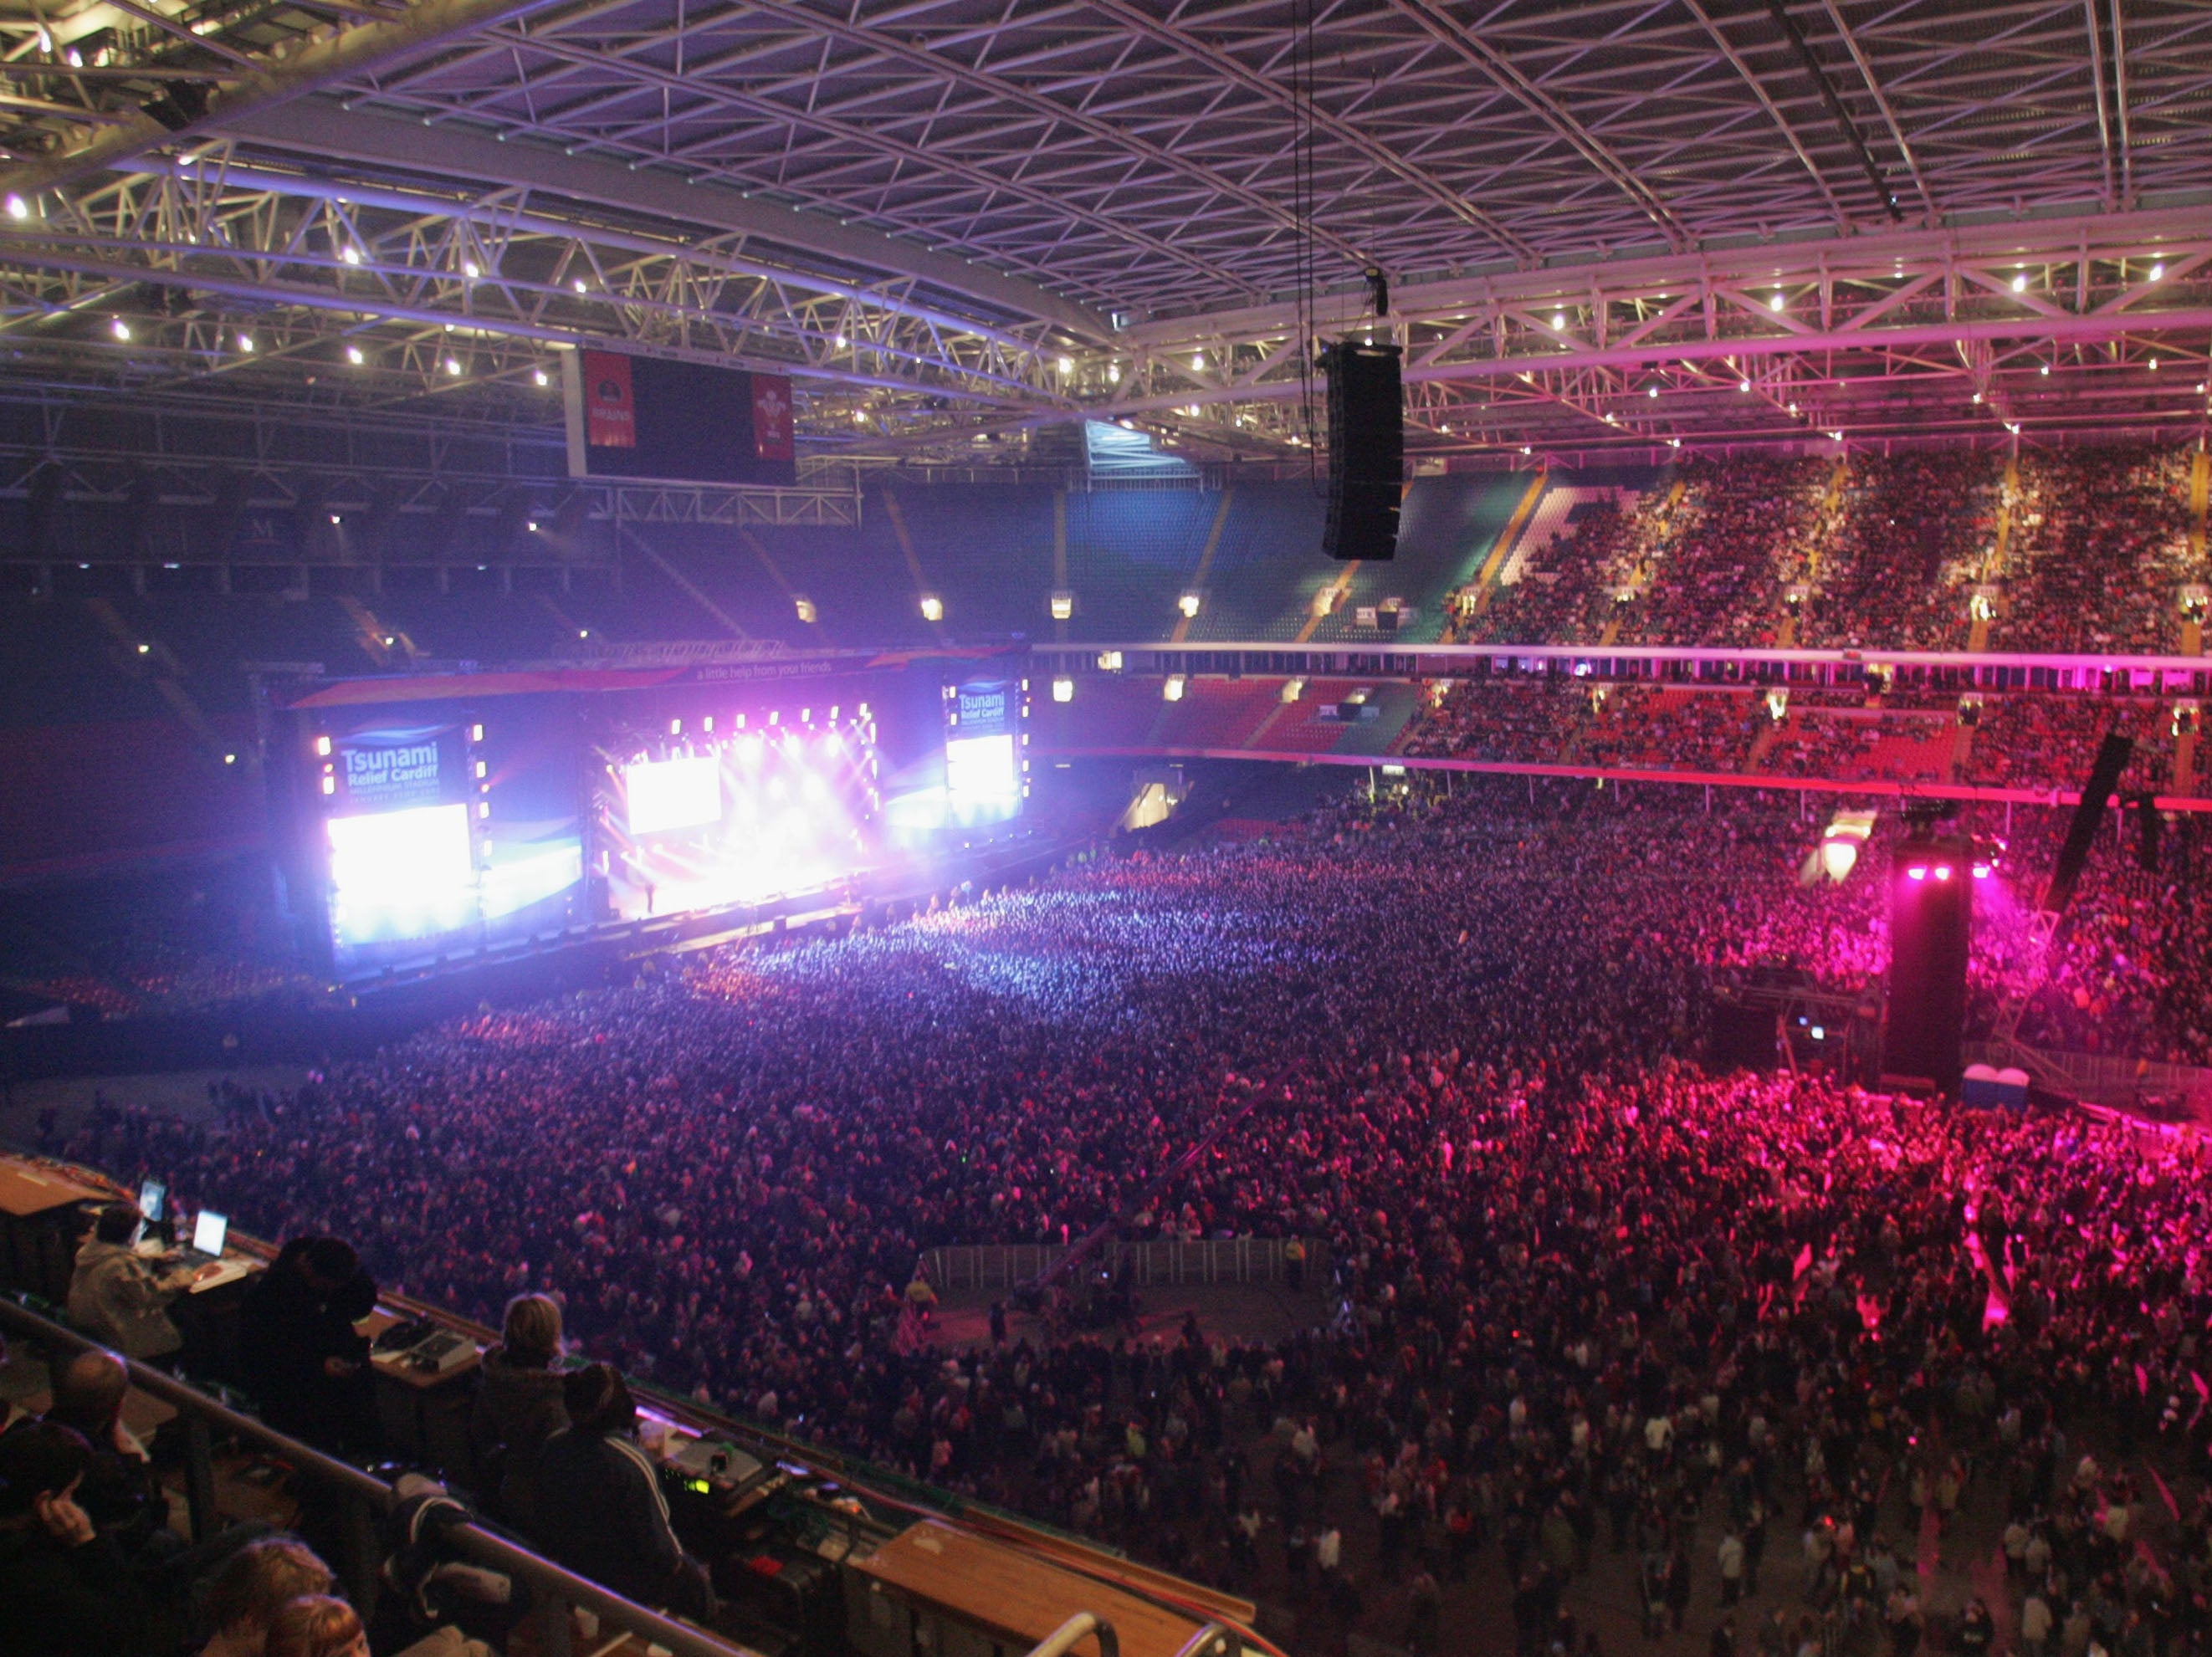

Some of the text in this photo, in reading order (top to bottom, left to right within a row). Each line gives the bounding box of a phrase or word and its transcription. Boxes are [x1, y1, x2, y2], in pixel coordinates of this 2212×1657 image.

[697, 661, 832, 680] a little help from your friends
[959, 691, 1005, 709] Tsunami
[341, 741, 438, 773] Tsunami
[348, 764, 438, 786] Relief Cardiff
